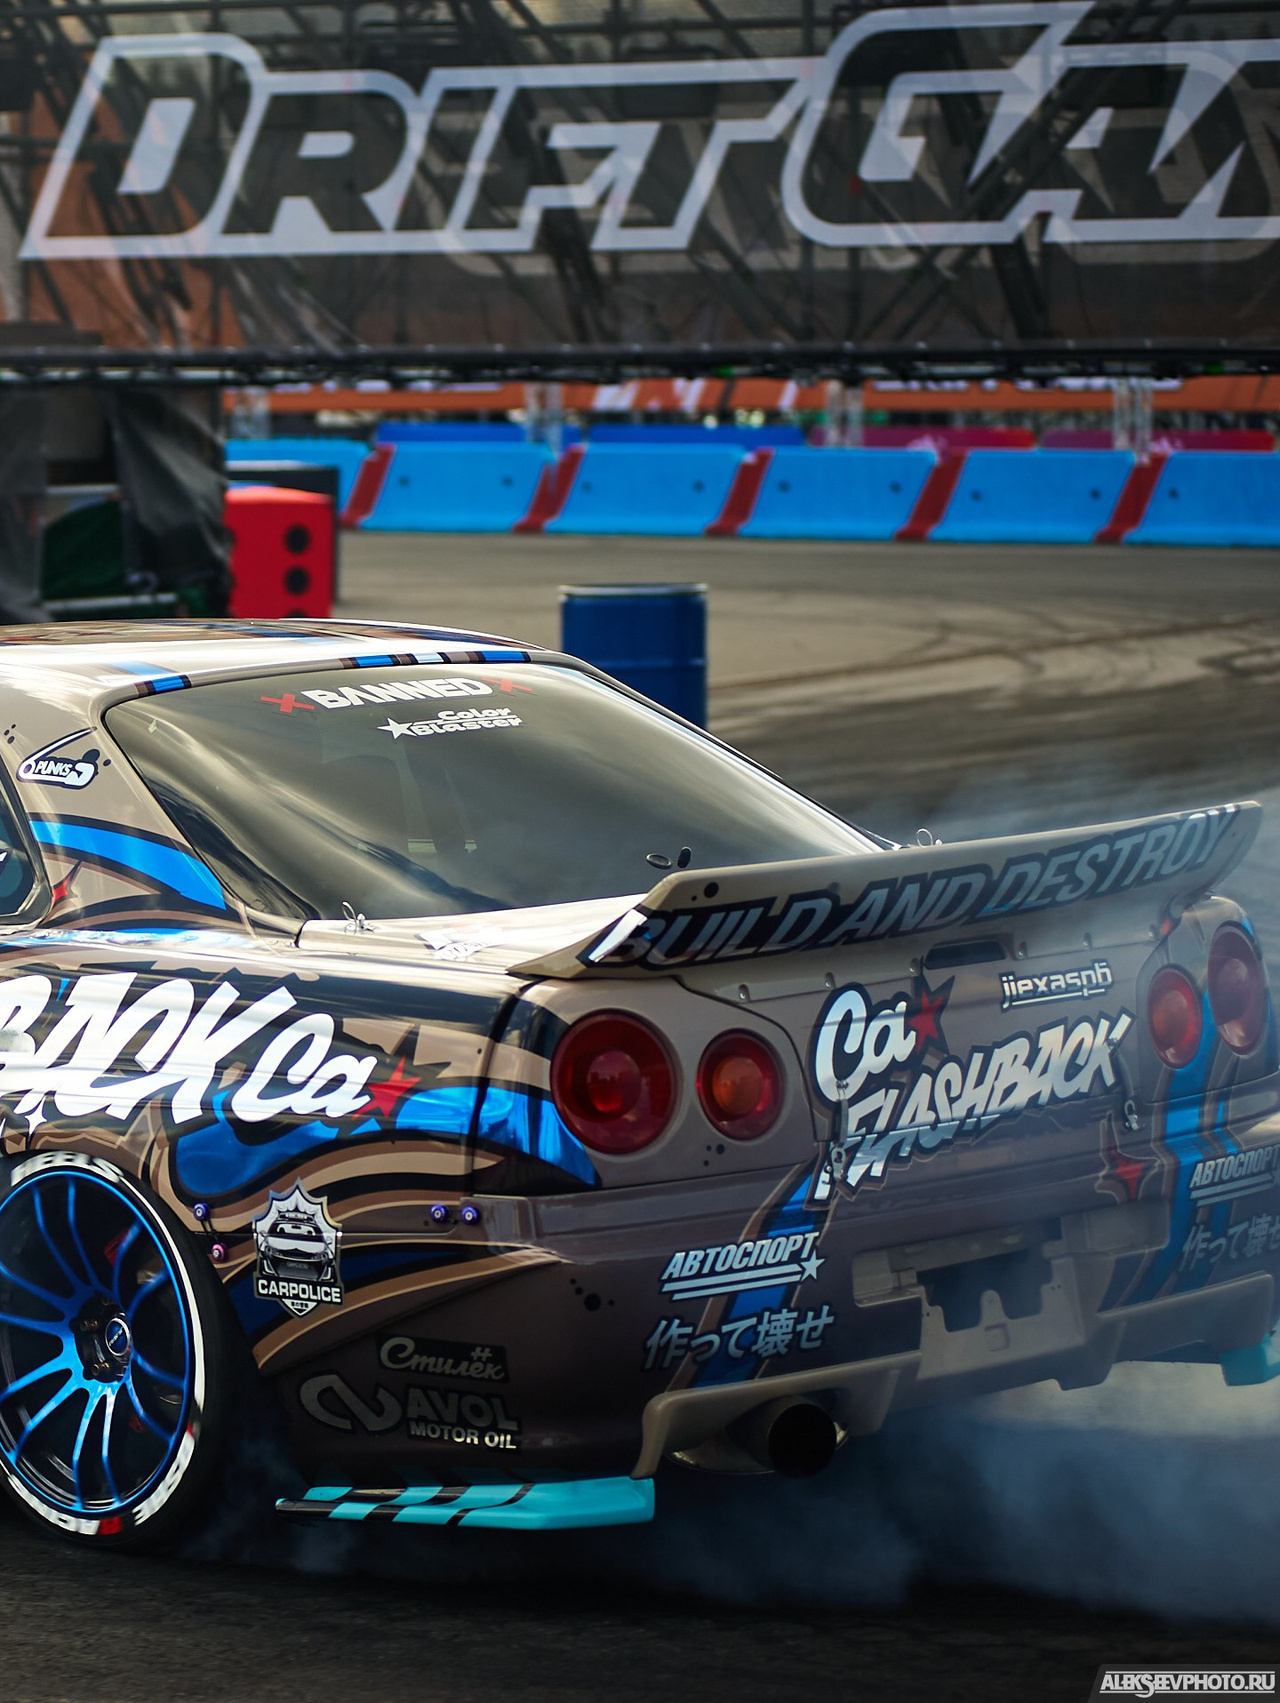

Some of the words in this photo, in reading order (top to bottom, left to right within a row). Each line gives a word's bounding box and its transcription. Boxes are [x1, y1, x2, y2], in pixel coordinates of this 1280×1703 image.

[20, 33, 824, 259] DRIFT
[780, 0, 1280, 247] GA
[301, 677, 494, 709] BANNED
[437, 706, 512, 722] Color
[412, 717, 523, 737] Blaster
[34, 760, 73, 776] PUNKS
[588, 897, 832, 965] BUILD
[819, 872, 987, 944] AND
[979, 804, 1235, 912] DESTROY
[231, 1012, 379, 1122] Ca
[815, 989, 917, 1102] Ca
[813, 1013, 1133, 1200] FLASHBACK
[661, 1231, 820, 1280] АВТОСПОРТ
[258, 1279, 342, 1303] CARPOLICE
[643, 1304, 835, 1370] 作って壊せ
[410, 1421, 480, 1446] MOTOR
[484, 1430, 517, 1449] OIL
